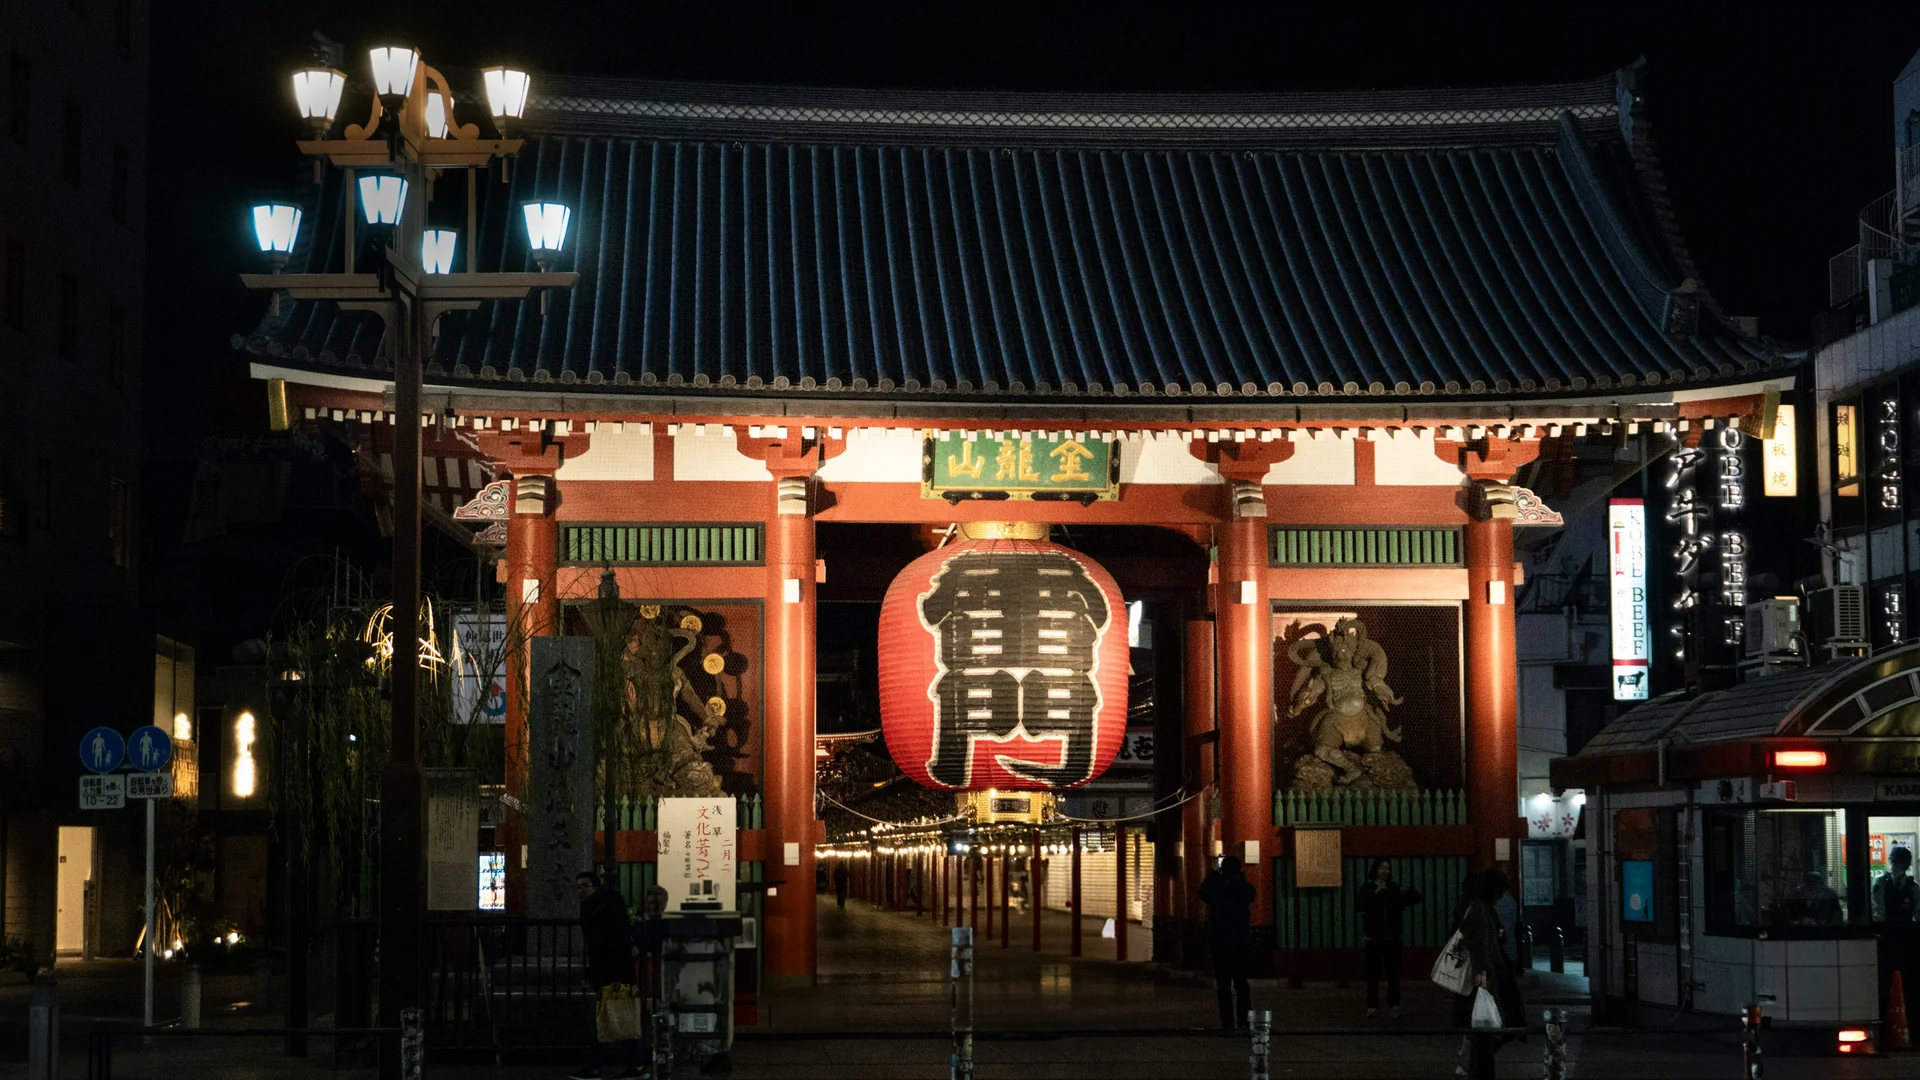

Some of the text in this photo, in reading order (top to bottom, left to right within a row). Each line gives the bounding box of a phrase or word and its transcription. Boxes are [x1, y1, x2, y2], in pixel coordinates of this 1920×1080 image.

[1629, 510, 1645, 656] KOBE BEEF
[1720, 427, 1746, 644] OBE BEEF
[917, 550, 1111, 788] 雷門
